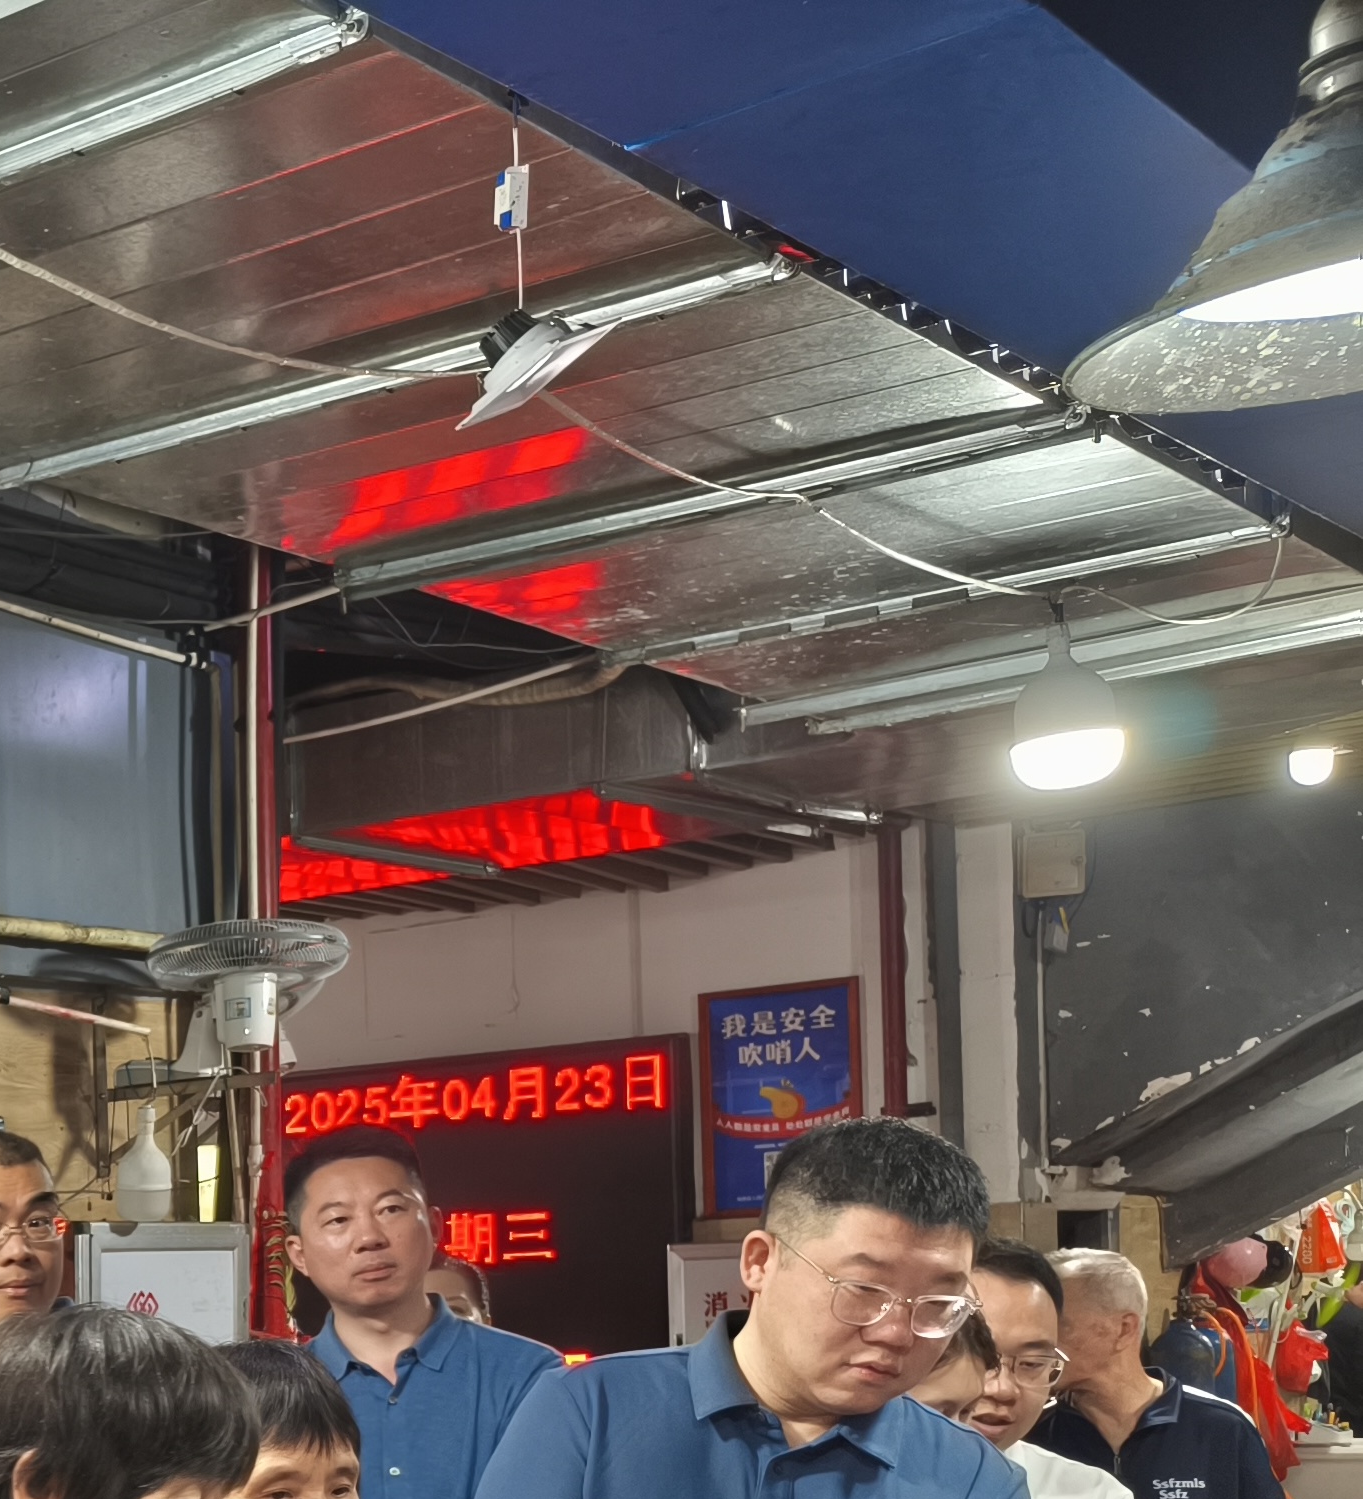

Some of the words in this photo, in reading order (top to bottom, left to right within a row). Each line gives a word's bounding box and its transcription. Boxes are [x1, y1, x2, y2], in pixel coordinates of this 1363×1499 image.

[721, 1004, 836, 1040] 我是安全
[738, 1037, 821, 1067] 吹哨人
[284, 1054, 666, 1134] 2025年04月23日
